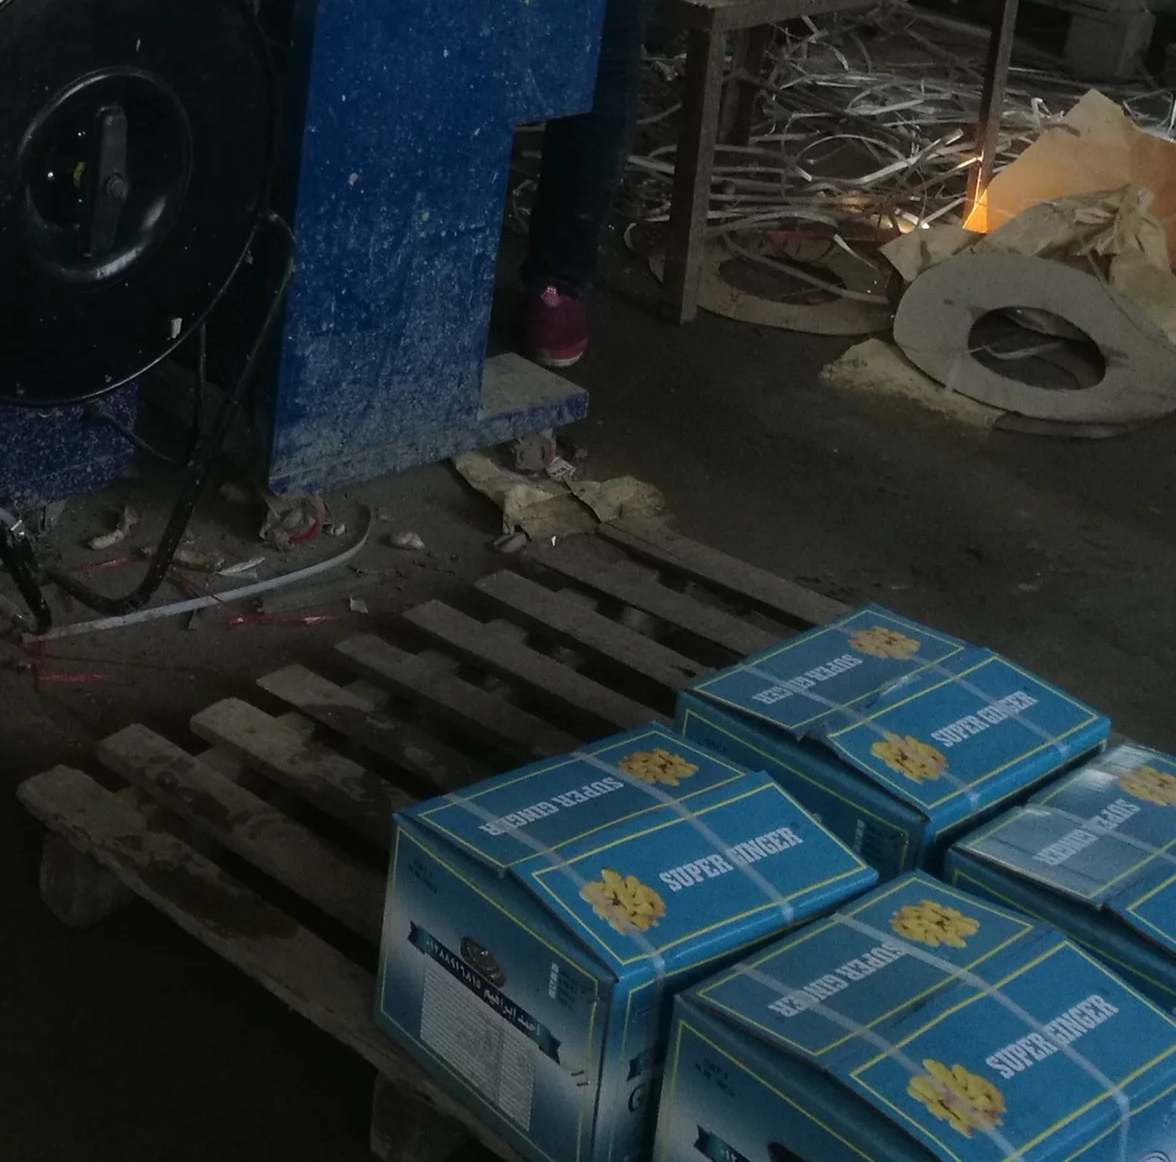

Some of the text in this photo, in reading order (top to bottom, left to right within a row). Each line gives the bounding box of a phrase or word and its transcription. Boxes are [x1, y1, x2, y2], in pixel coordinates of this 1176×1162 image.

[751, 654, 863, 705] SUPER GINGER
[930, 690, 1039, 748] SUPER GINGER
[478, 777, 624, 836] SUPER GINGER
[658, 826, 804, 892] SUPER GINGER
[1031, 828, 1100, 866] GINGER
[768, 939, 910, 1018] SUPER GINGER
[985, 993, 1120, 1079] SUPER GINGER
